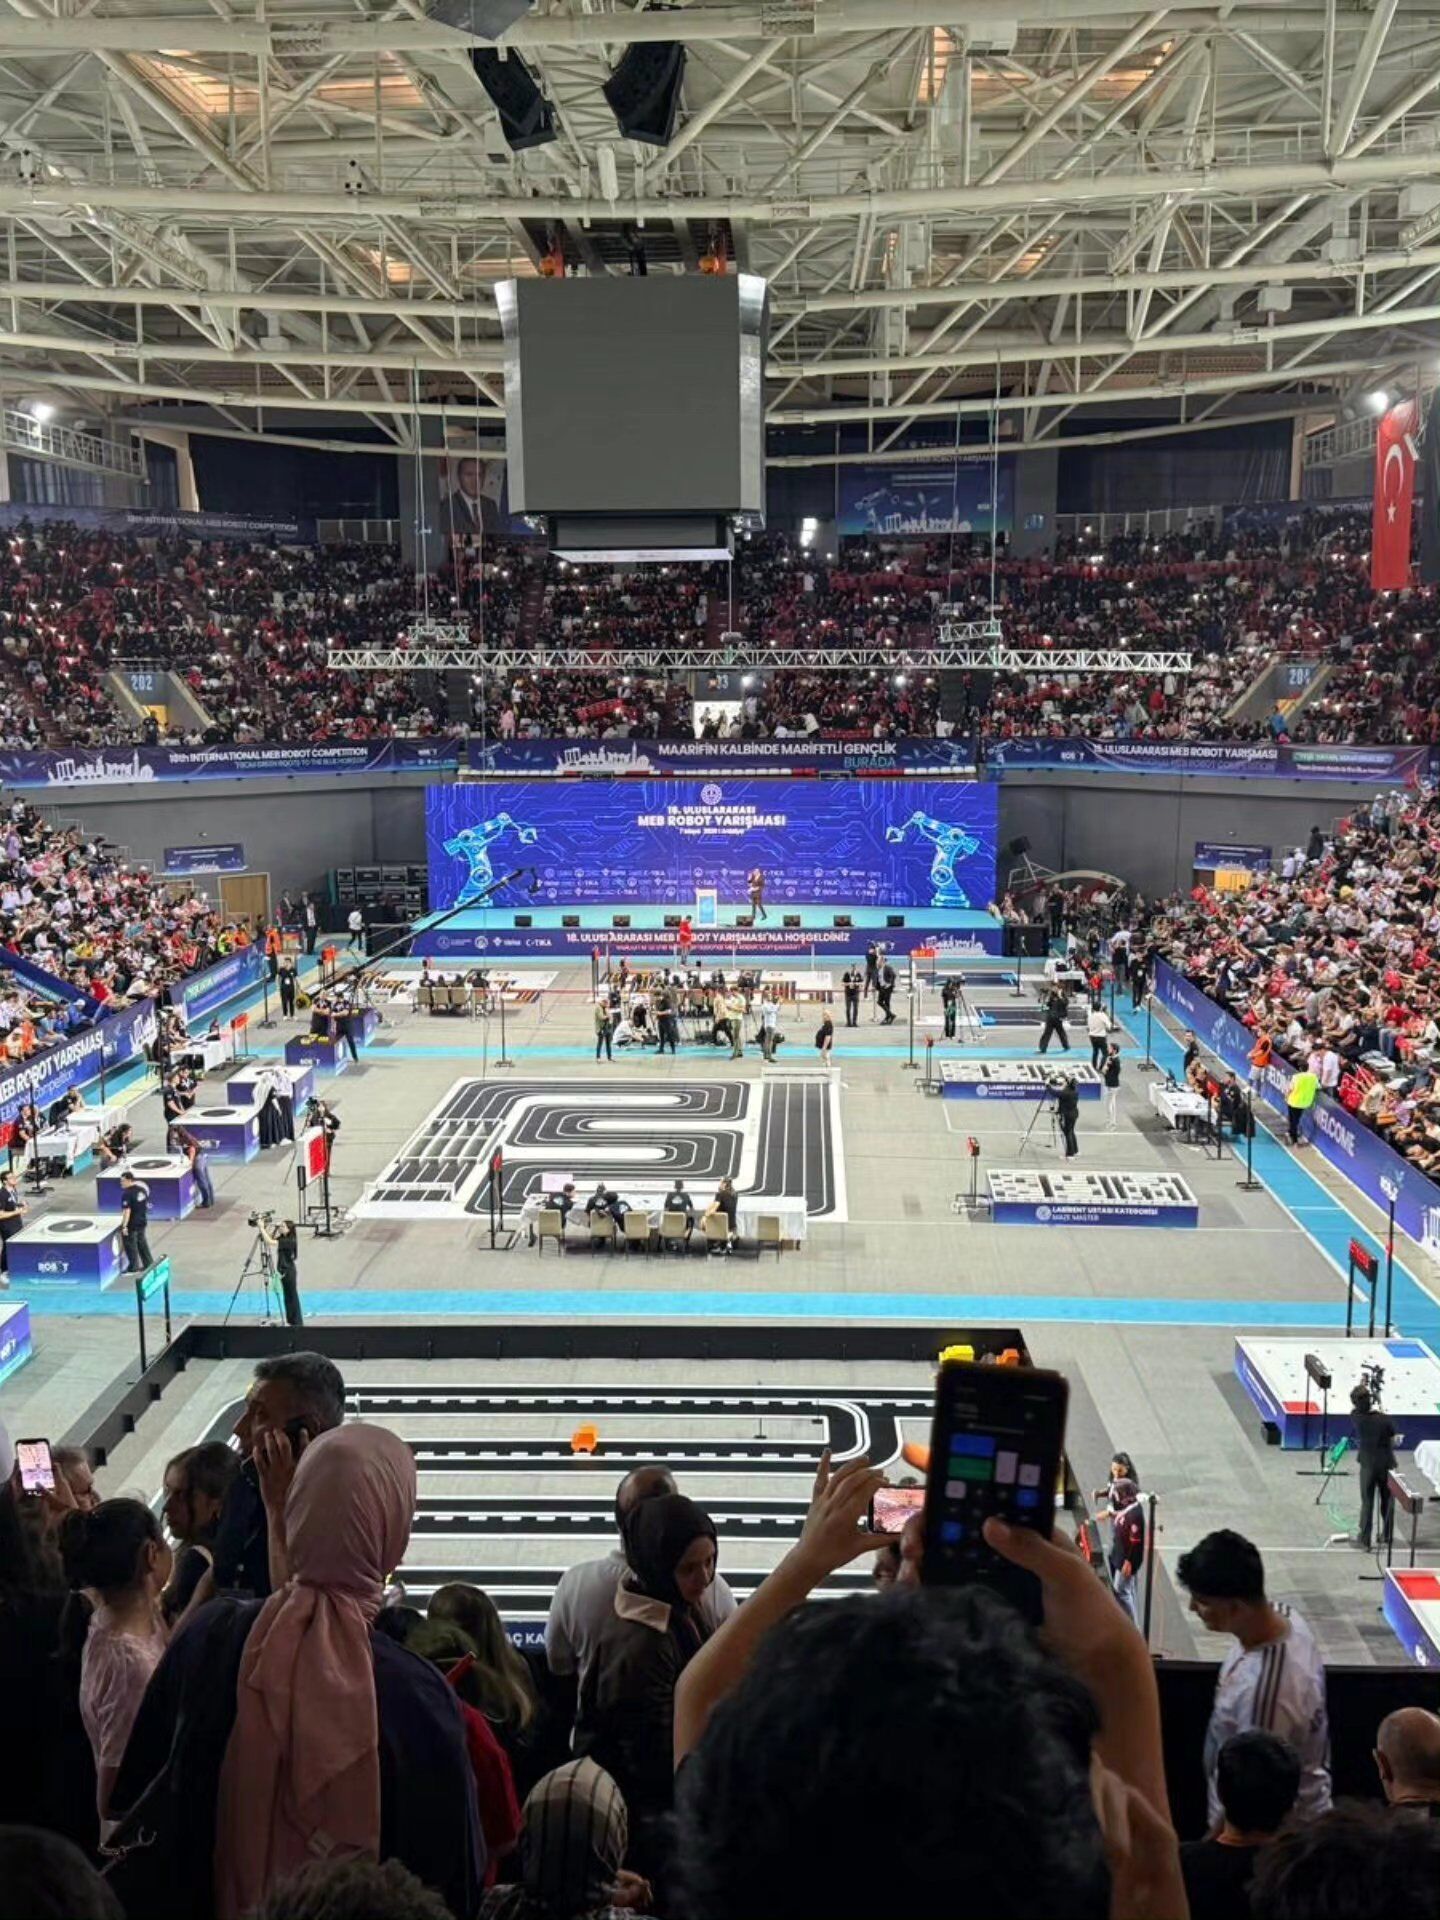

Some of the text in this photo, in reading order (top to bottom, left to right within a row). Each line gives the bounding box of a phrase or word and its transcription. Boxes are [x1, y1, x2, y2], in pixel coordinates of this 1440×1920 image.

[131, 675, 153, 690] 202
[190, 750, 260, 763] INTERNATIONAL
[281, 749, 311, 758] ROBOT
[312, 747, 368, 757] COMPETITION
[658, 741, 897, 757] MAARİFİN KALBİNDE MARİFETLİ GENÇLİK
[1190, 747, 1223, 757] ROBOT
[1225, 748, 1278, 761] YARIŞMASI
[844, 757, 897, 768] BURADA
[637, 815, 786, 829] MEB ROBOT YARIŞMASI
[654, 932, 675, 942] MEB
[713, 932, 783, 944] YARIŞMASI'NA
[785, 932, 850, 944] HOŞGELDİNİZ
[0, 1077, 17, 1104] EB
[16, 1056, 53, 1092] ROBOT
[53, 1029, 105, 1071] YARIŞMASI
[1313, 1105, 1356, 1158] WELCOME
[526, 1633, 545, 1644] KA
